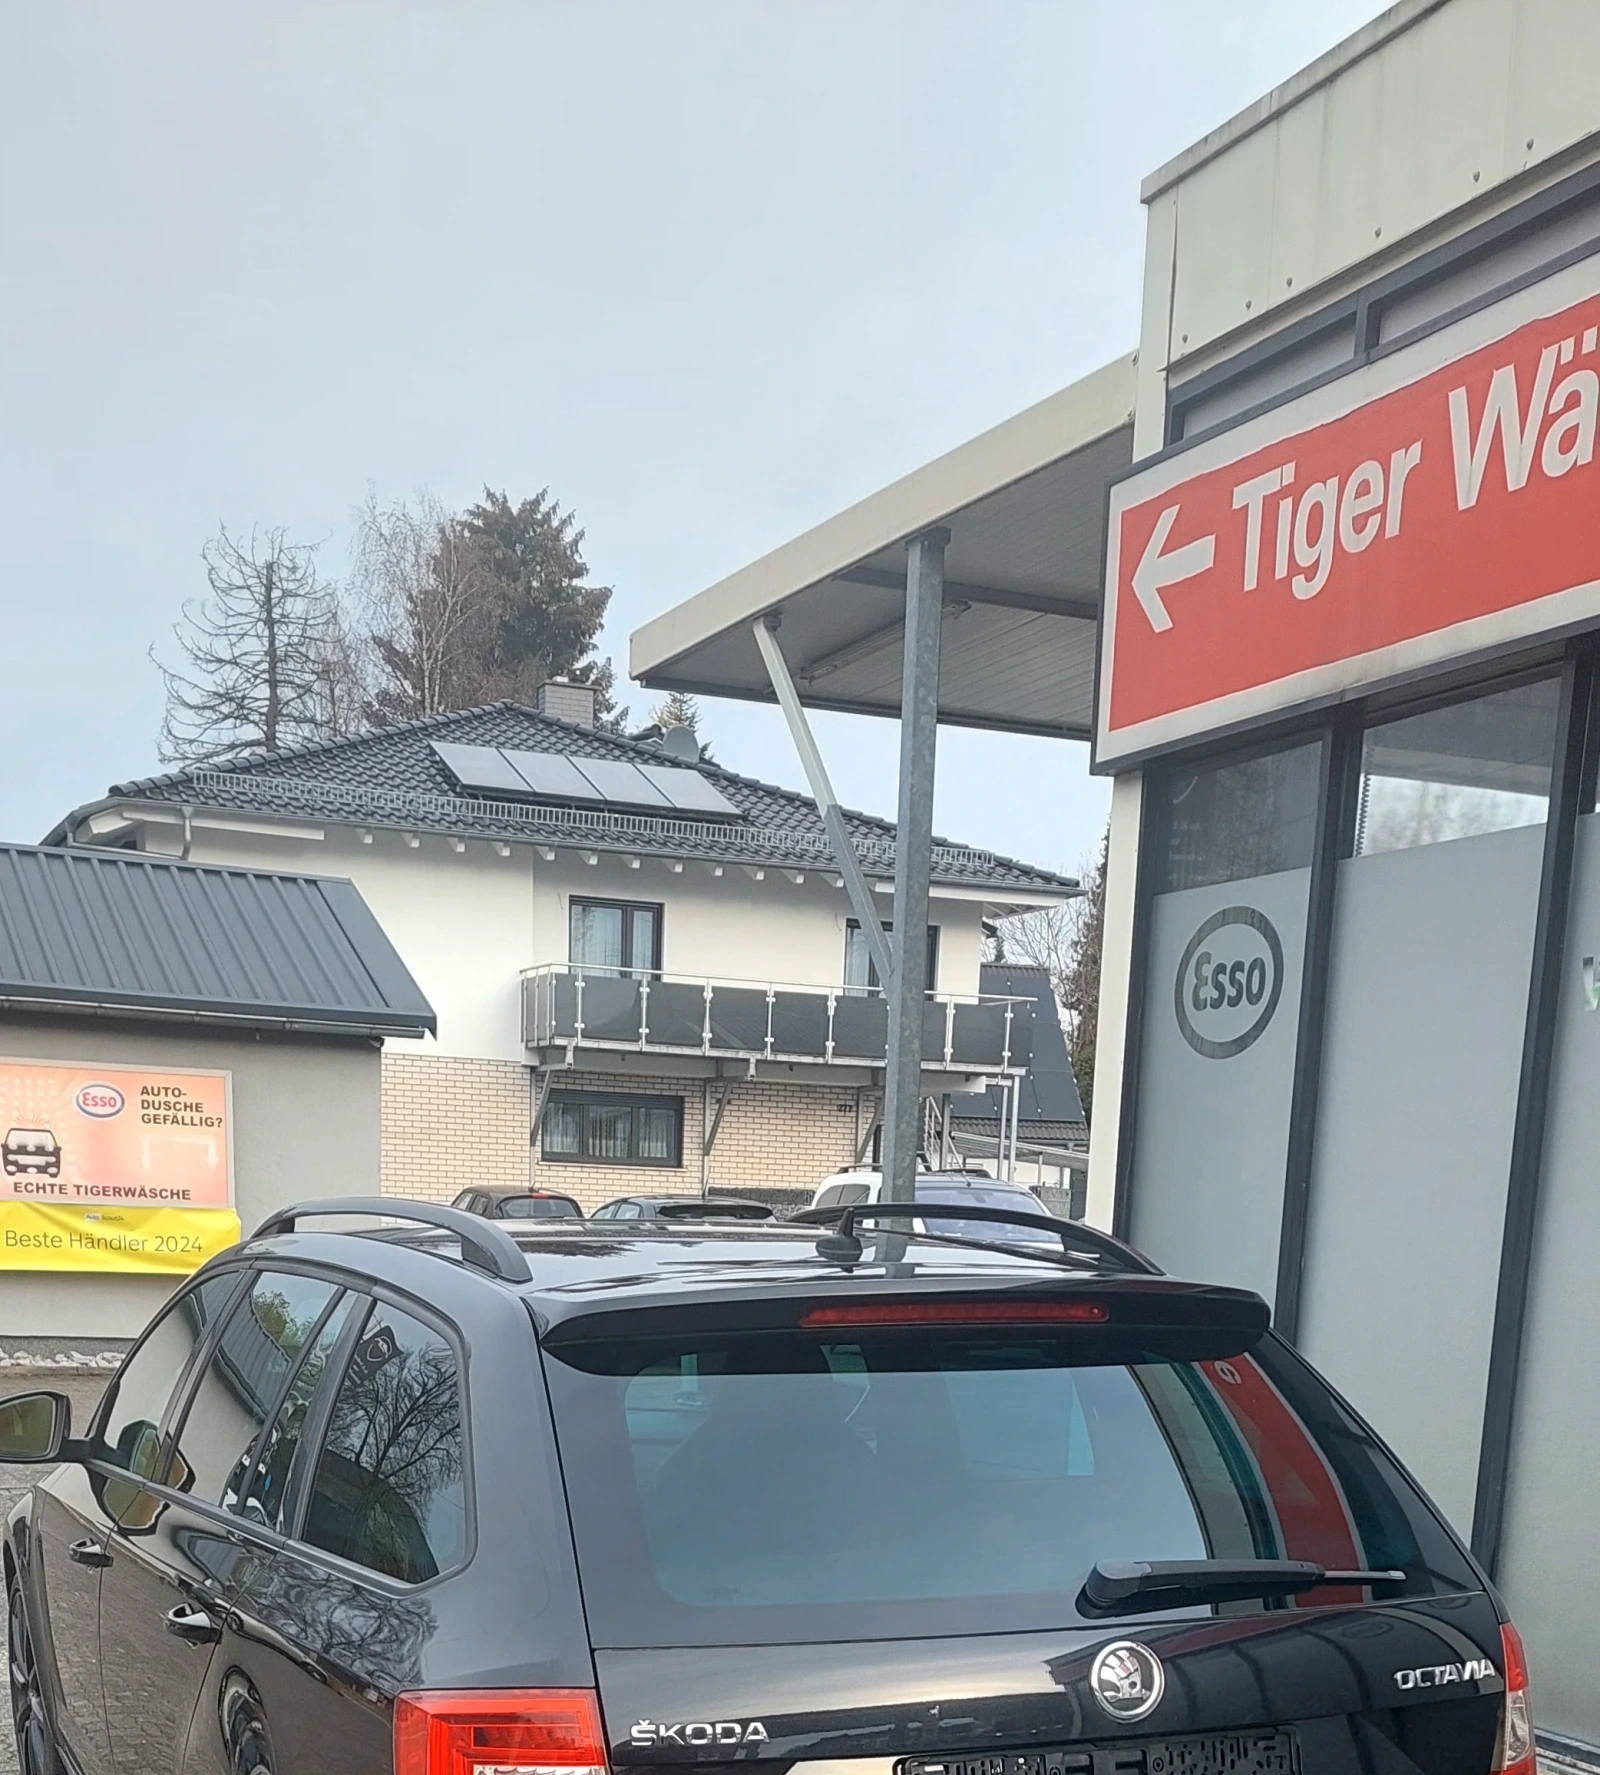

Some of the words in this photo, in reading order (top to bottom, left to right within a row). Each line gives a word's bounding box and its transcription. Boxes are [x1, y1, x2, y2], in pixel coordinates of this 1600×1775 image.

[1232, 439, 1423, 600] Tiger
[140, 1086, 187, 1097] AUTO-
[141, 1100, 204, 1113] DUSCHE
[141, 1112, 223, 1128] GEFÄLLIG?
[13, 1182, 68, 1195] ECHTE
[73, 1184, 191, 1200] TIGERWÄSCHE
[5, 1230, 62, 1249] Beste
[69, 1232, 148, 1251] Händler
[154, 1235, 203, 1252] 2024
[1393, 1658, 1496, 1690] OCTAVIA
[630, 1719, 771, 1746] ŠKODA
